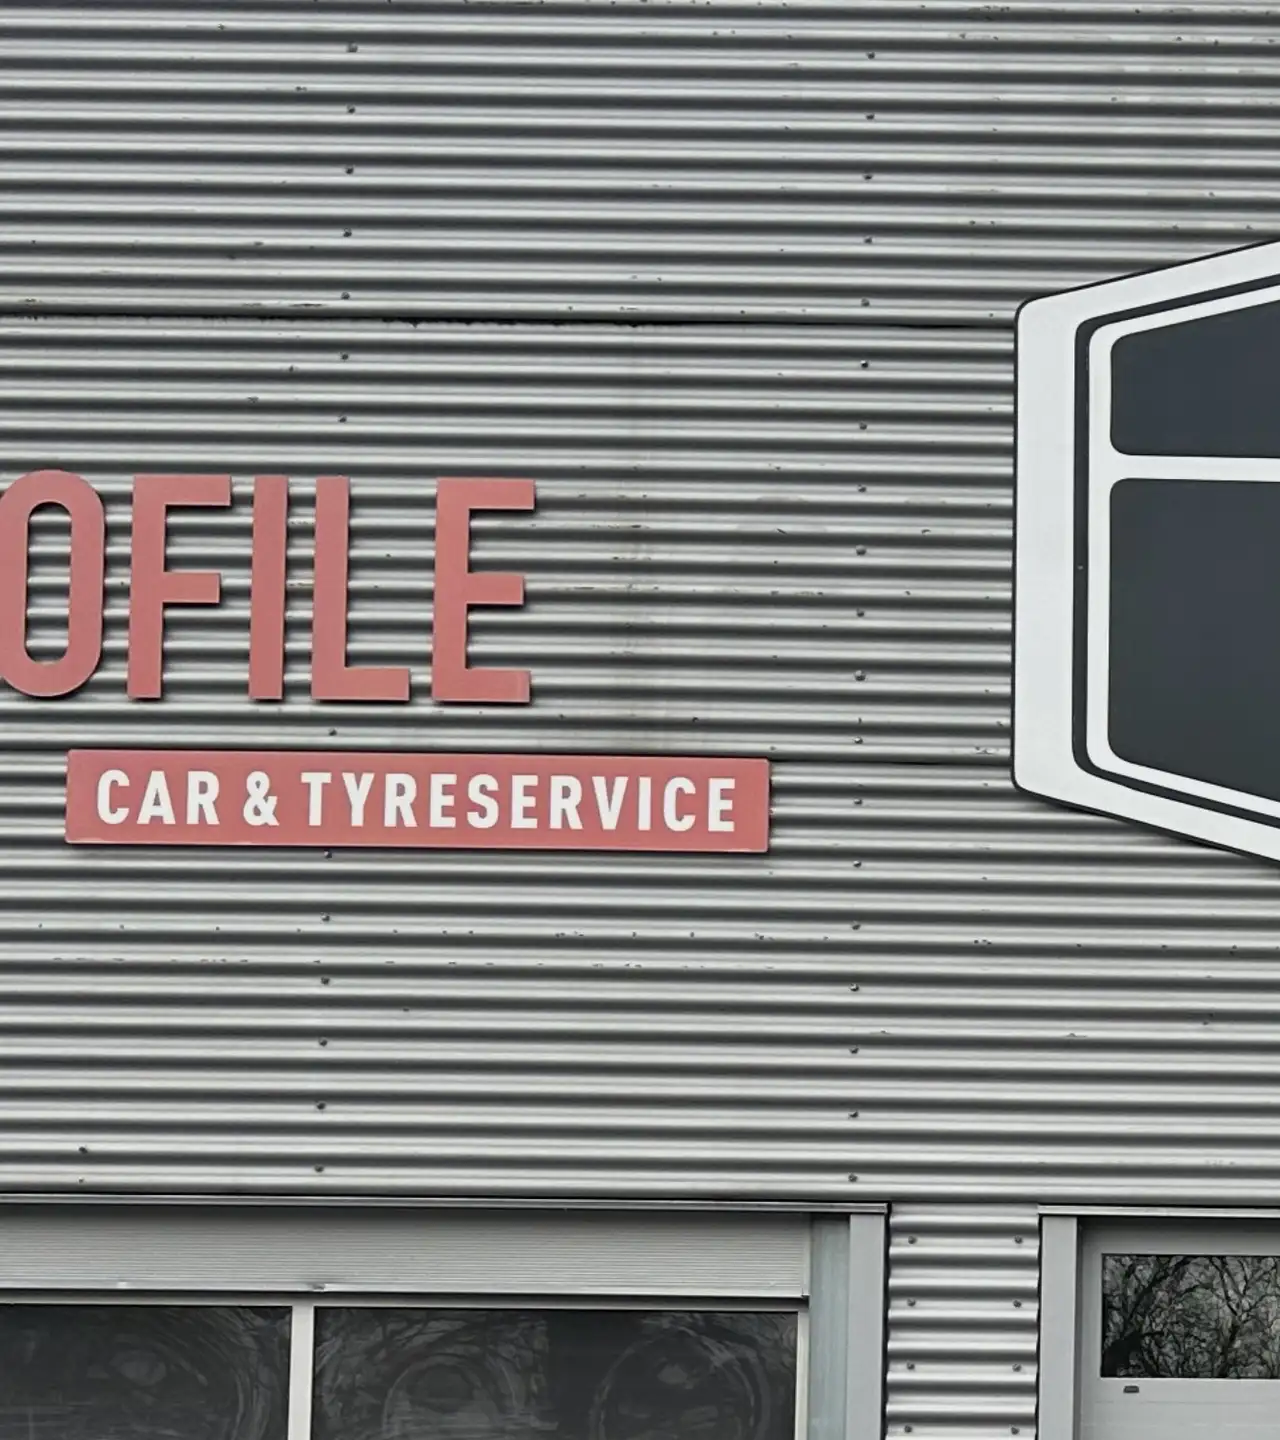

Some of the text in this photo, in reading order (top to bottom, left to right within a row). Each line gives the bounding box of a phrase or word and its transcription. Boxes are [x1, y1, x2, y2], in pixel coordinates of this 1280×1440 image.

[0, 469, 536, 703] OFILE
[97, 769, 736, 833] CAR & TYRESERVICE
